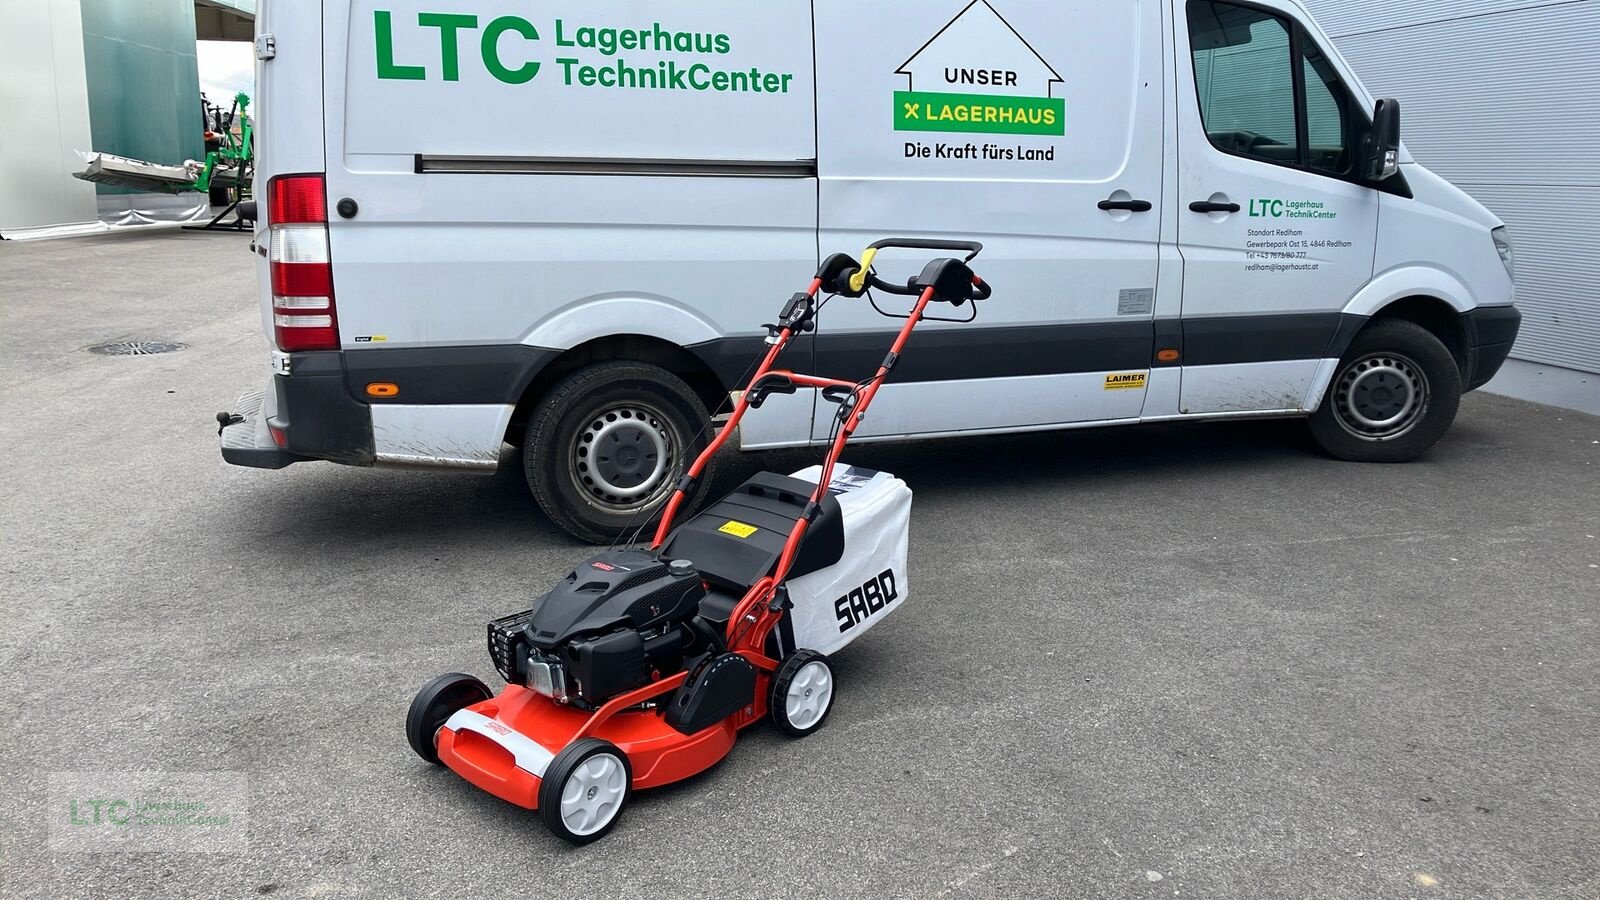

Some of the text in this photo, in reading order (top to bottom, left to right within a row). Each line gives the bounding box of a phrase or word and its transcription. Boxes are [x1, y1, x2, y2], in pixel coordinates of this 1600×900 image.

[555, 19, 731, 56] Lagerhaus
[374, 10, 541, 85] LTC
[556, 58, 793, 94] TechnikCenter
[944, 67, 1018, 87] UNSER
[926, 104, 1055, 125] LAGERHAUS
[904, 142, 1054, 161] Die Kraft fürs Land
[1249, 199, 1283, 218] LTC
[1285, 200, 1323, 209] Lagerhaus
[1285, 210, 1336, 218] TechnikCenter
[1247, 229, 1303, 237] Standort Redlham
[1246, 241, 1288, 249] Gewerbepark
[1301, 241, 1309, 249] 15,
[1245, 263, 1319, 272] redlham@lagerhaustc.at
[1106, 374, 1145, 382] LAIMER
[834, 568, 898, 634] SABO
